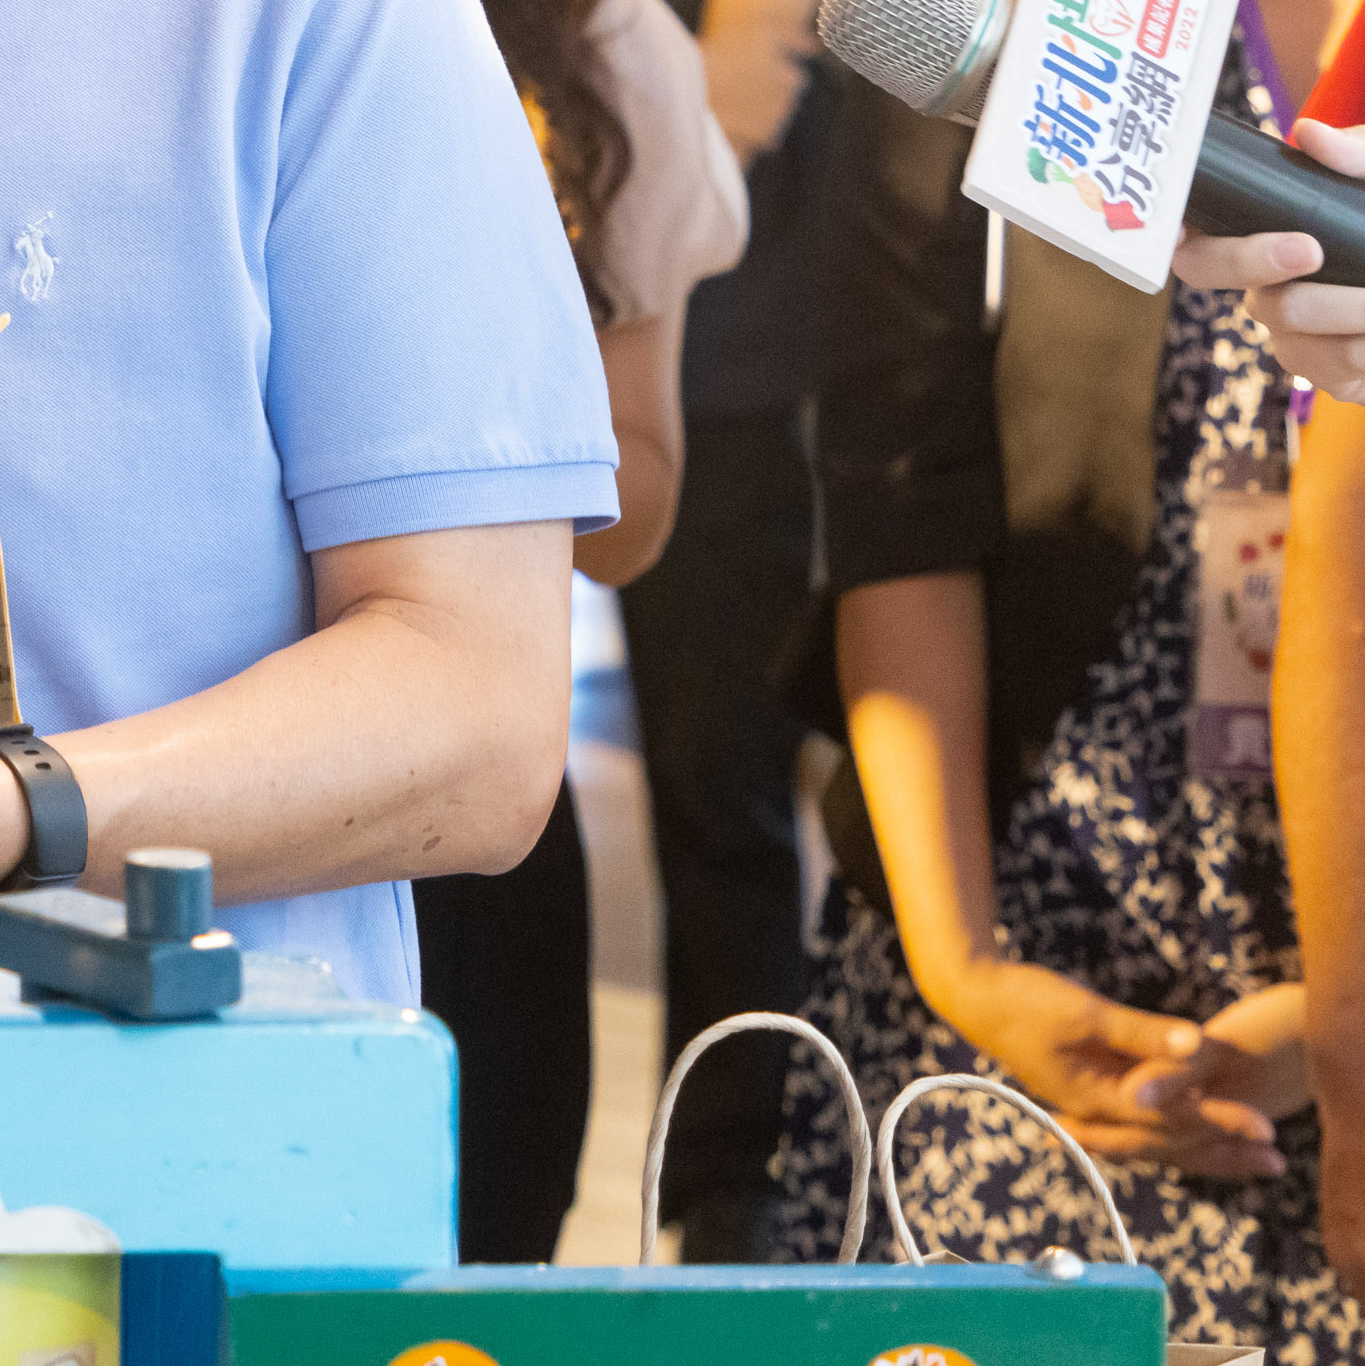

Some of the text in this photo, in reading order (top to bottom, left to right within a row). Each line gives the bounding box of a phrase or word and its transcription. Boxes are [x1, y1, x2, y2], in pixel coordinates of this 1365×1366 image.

[1174, 7, 1199, 52] 2022
[1093, 51, 1181, 213] 分享網
